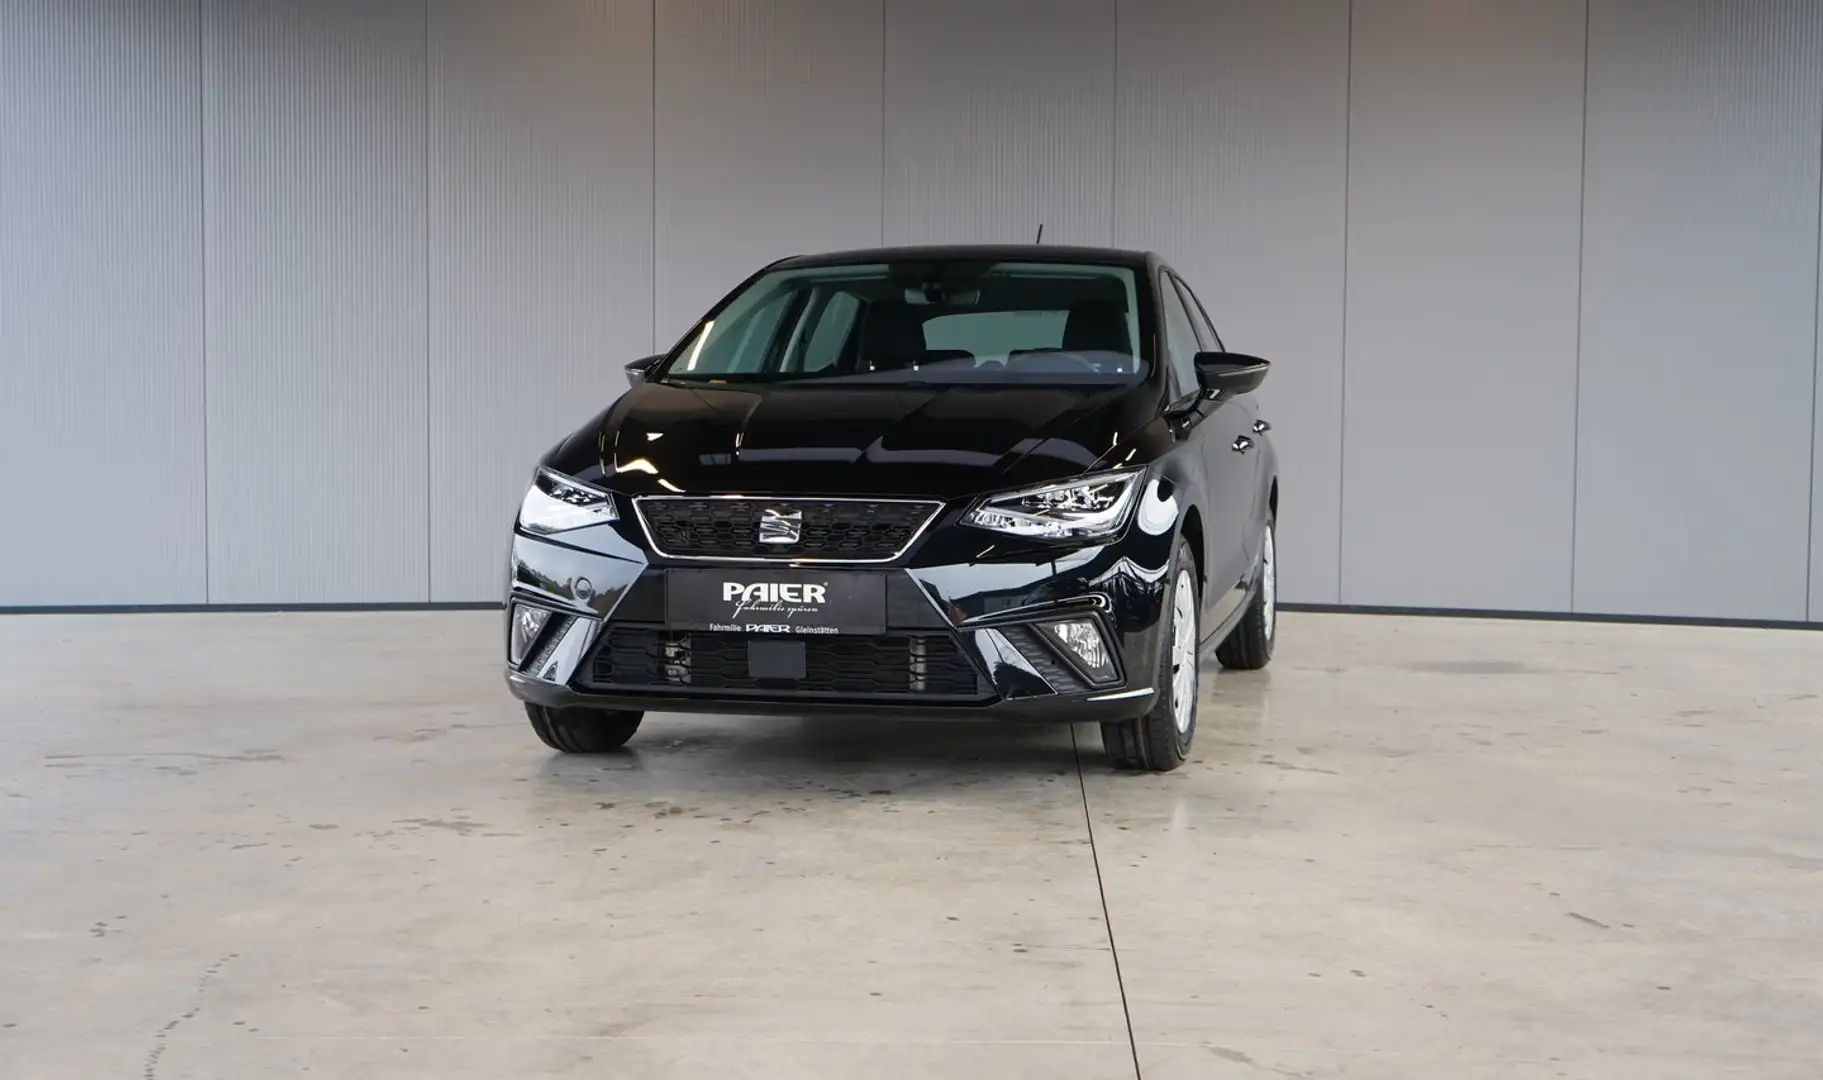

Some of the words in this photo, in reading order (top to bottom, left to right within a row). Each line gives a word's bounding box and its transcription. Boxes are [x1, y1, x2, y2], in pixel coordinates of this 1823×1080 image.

[722, 581, 826, 603] PAIER
[708, 622, 742, 632] Fahrmilie
[745, 623, 791, 633] PAIER
[795, 625, 839, 635] Gleinstätten
